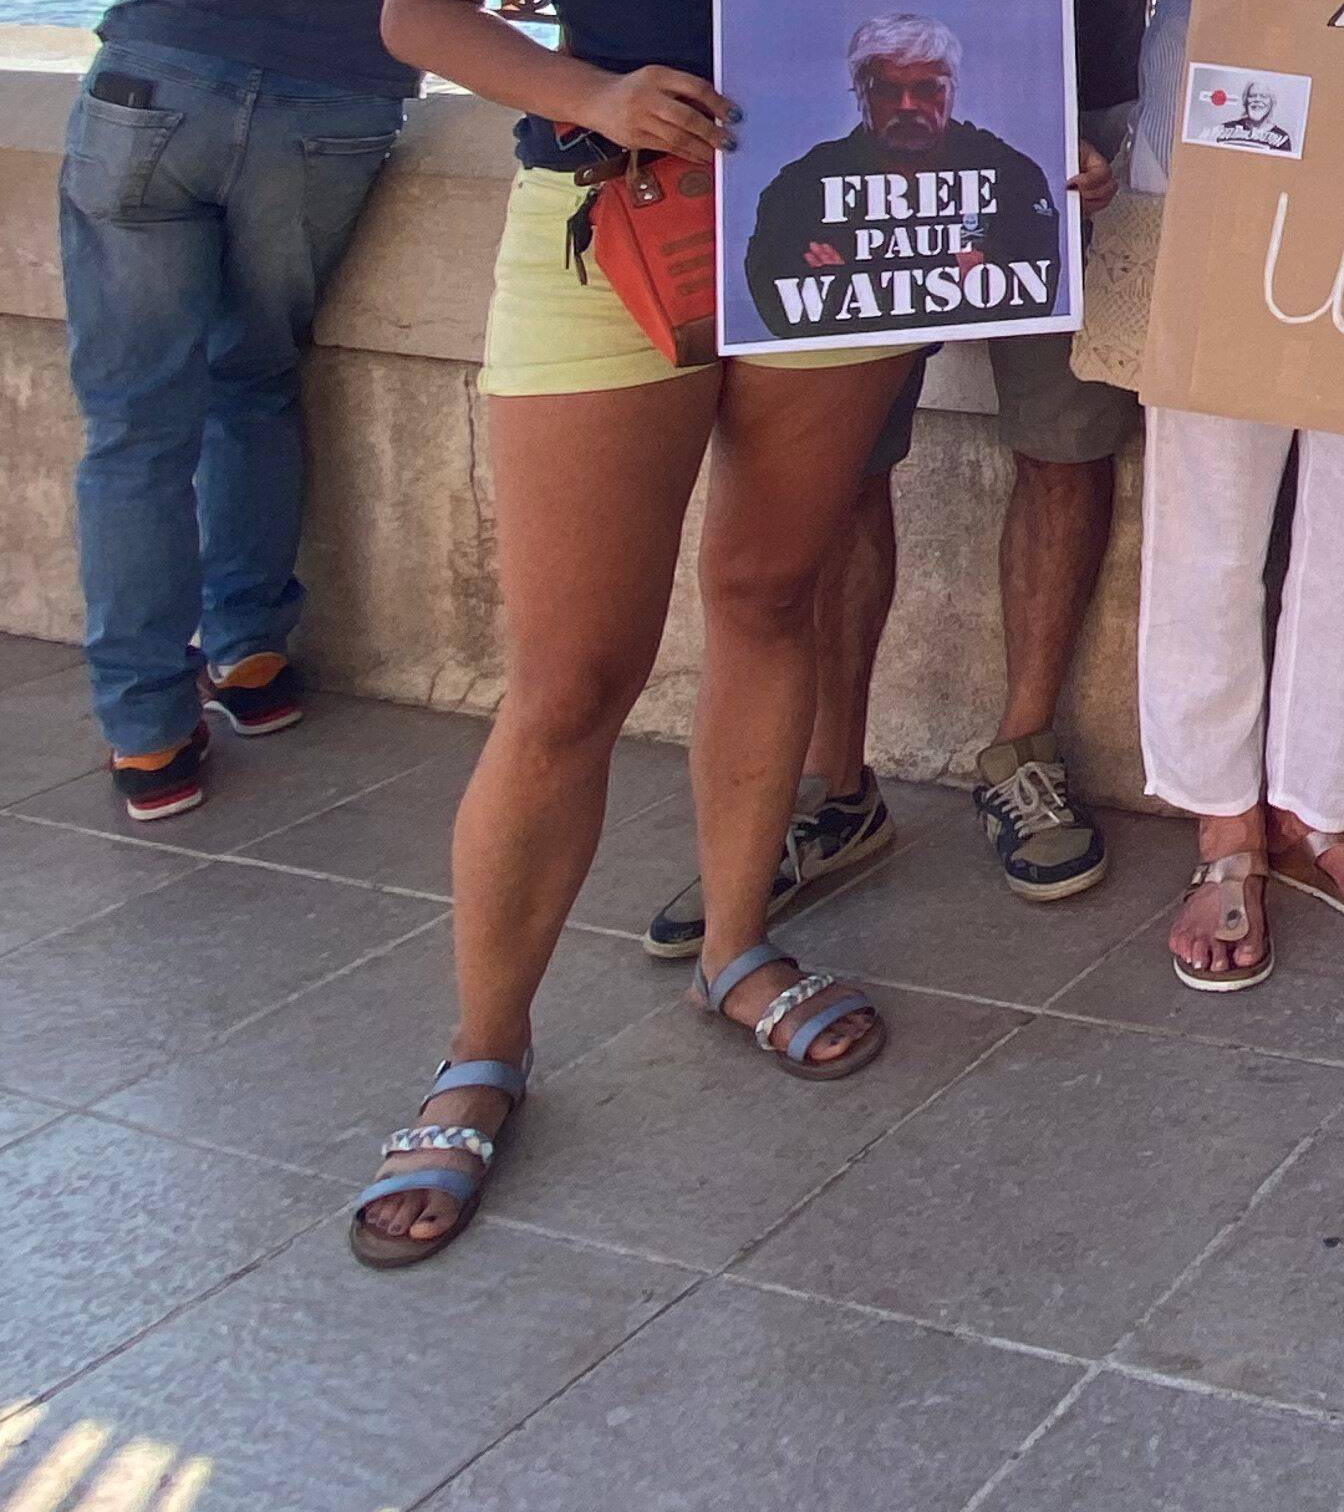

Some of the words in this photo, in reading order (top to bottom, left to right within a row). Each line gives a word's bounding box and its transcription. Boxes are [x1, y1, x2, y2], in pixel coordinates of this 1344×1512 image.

[820, 167, 998, 224] FREE
[854, 223, 974, 261] PAUL
[774, 259, 1051, 325] WATSON
